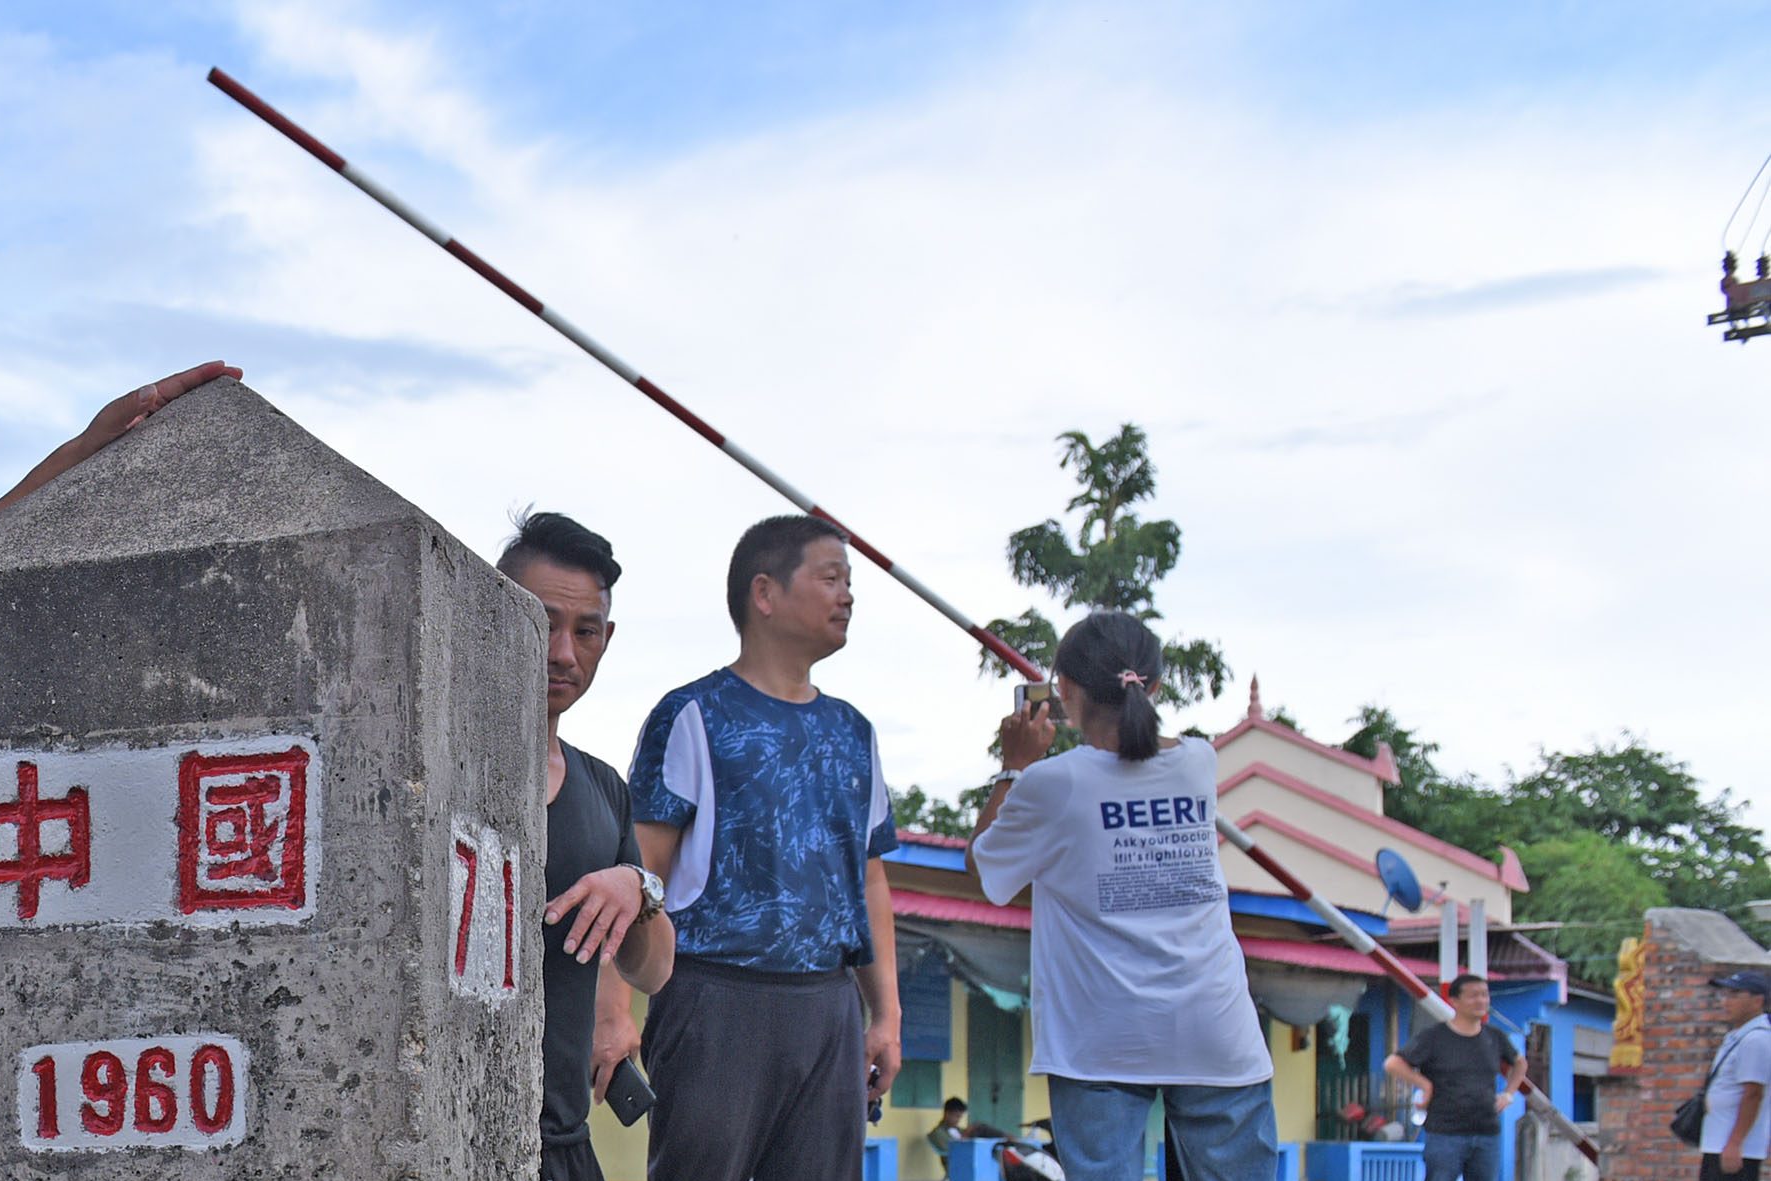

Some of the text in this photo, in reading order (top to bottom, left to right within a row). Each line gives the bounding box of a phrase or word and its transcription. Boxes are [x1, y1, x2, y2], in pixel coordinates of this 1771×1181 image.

[1114, 836, 1136, 848] Ask
[1139, 836, 1169, 848] your
[455, 838, 515, 989] 71
[31, 1045, 235, 1138] 1960
